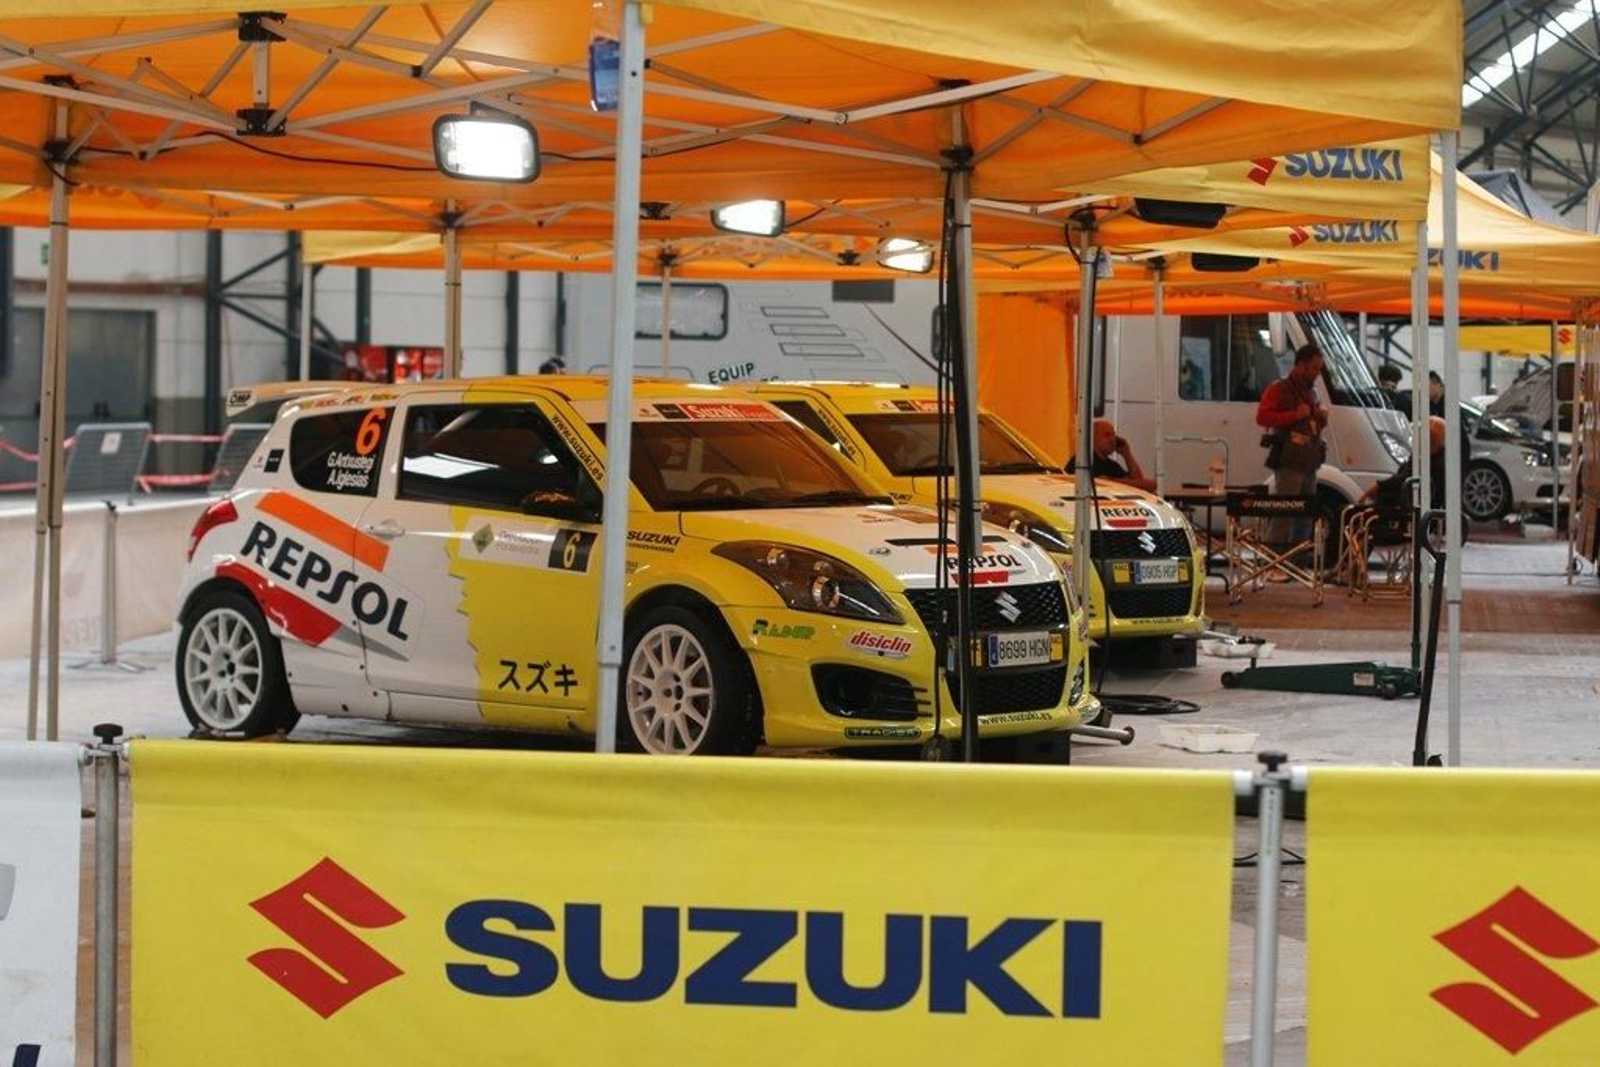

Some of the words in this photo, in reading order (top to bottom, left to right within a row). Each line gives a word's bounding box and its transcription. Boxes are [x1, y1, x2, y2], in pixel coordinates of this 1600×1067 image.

[1285, 149, 1403, 181] SUZUKI
[1313, 220, 1399, 242] SUZUKI
[708, 362, 754, 385] EQUIP
[356, 407, 386, 455] 6
[551, 414, 604, 480] www.suzuki.es
[563, 531, 580, 569] 6
[627, 530, 681, 546] SUZUKI
[240, 520, 409, 642] REPSOL
[850, 631, 911, 653] disiclin
[1000, 641, 1027, 660] 8699
[1030, 638, 1049, 656] HGN
[498, 660, 578, 697] スズキ
[445, 899, 1102, 1019] SUZUKI
